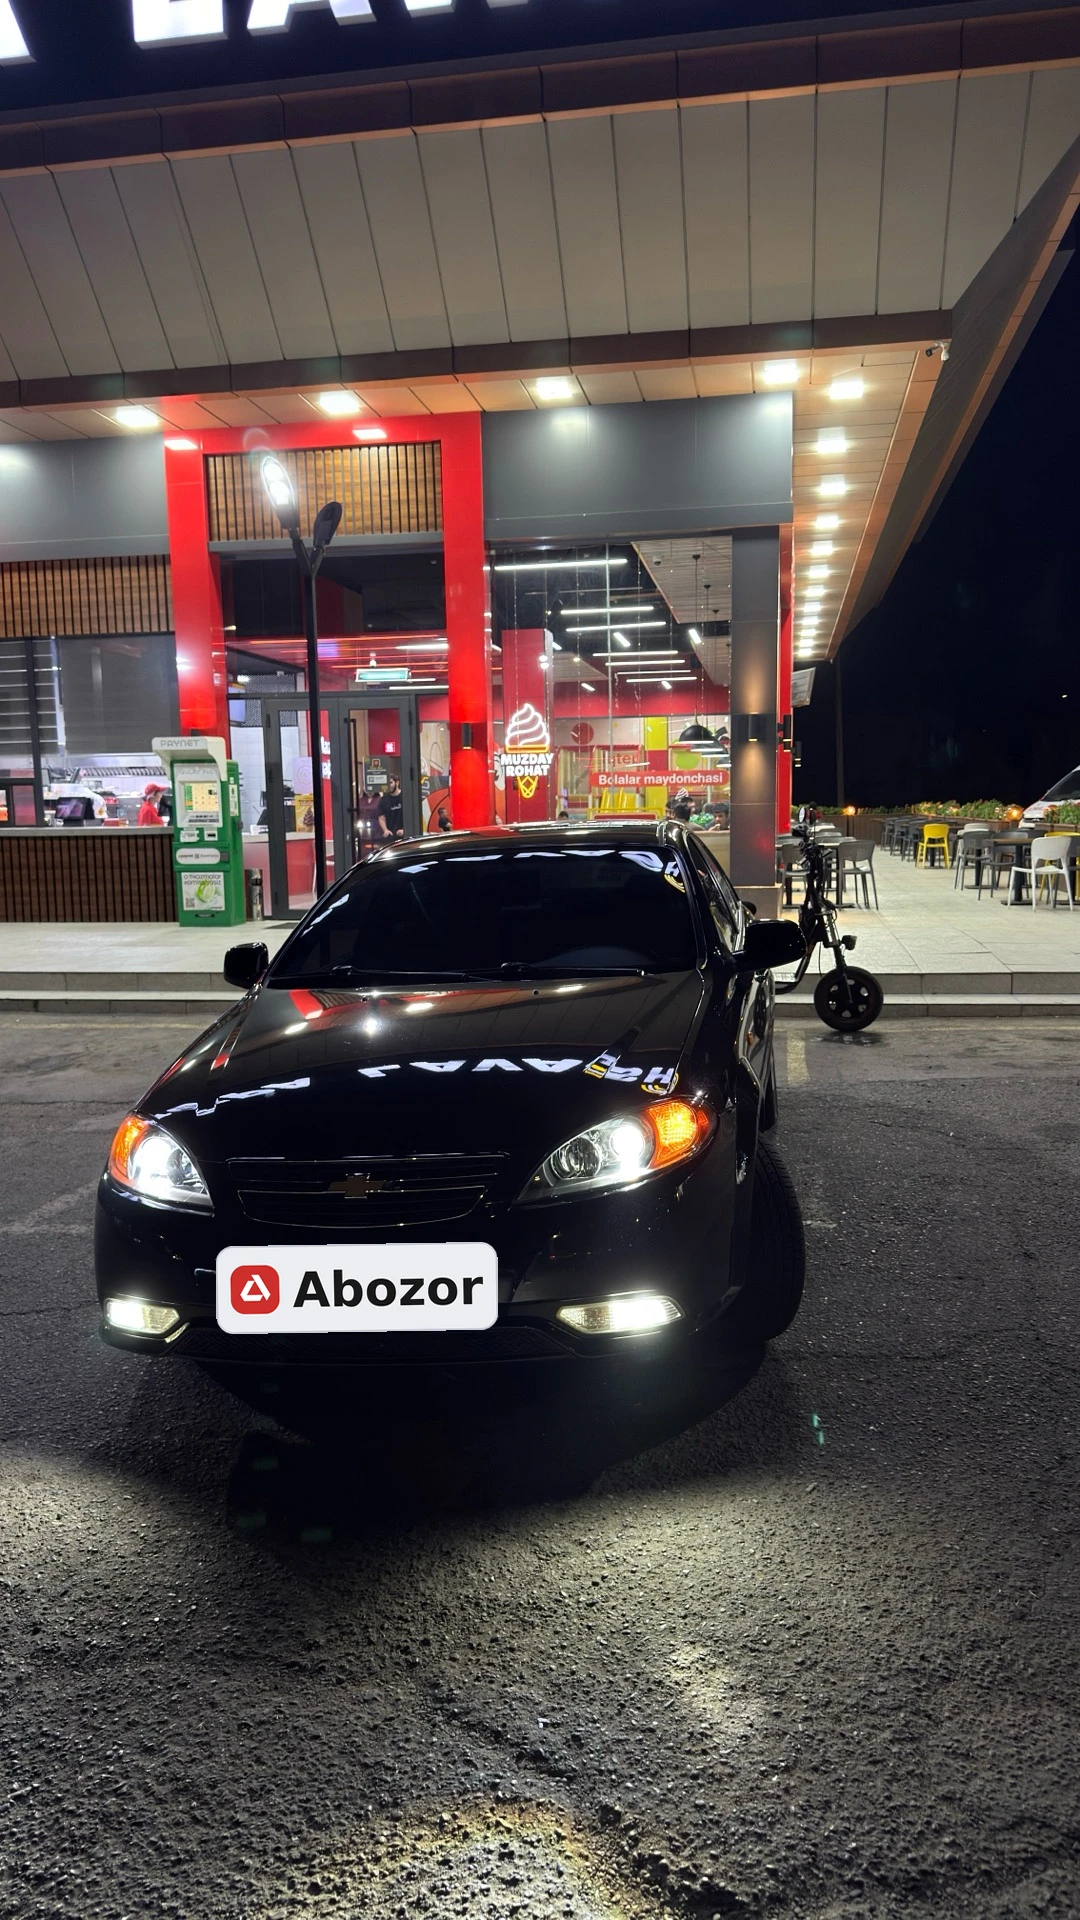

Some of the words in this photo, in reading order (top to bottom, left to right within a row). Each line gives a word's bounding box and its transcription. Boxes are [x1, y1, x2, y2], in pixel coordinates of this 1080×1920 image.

[160, 739, 200, 748] PAYNET
[500, 753, 554, 766] MUZDAY
[505, 764, 550, 776] ROHAT
[598, 774, 642, 785] Bolalar
[643, 773, 724, 787] maydonchasi
